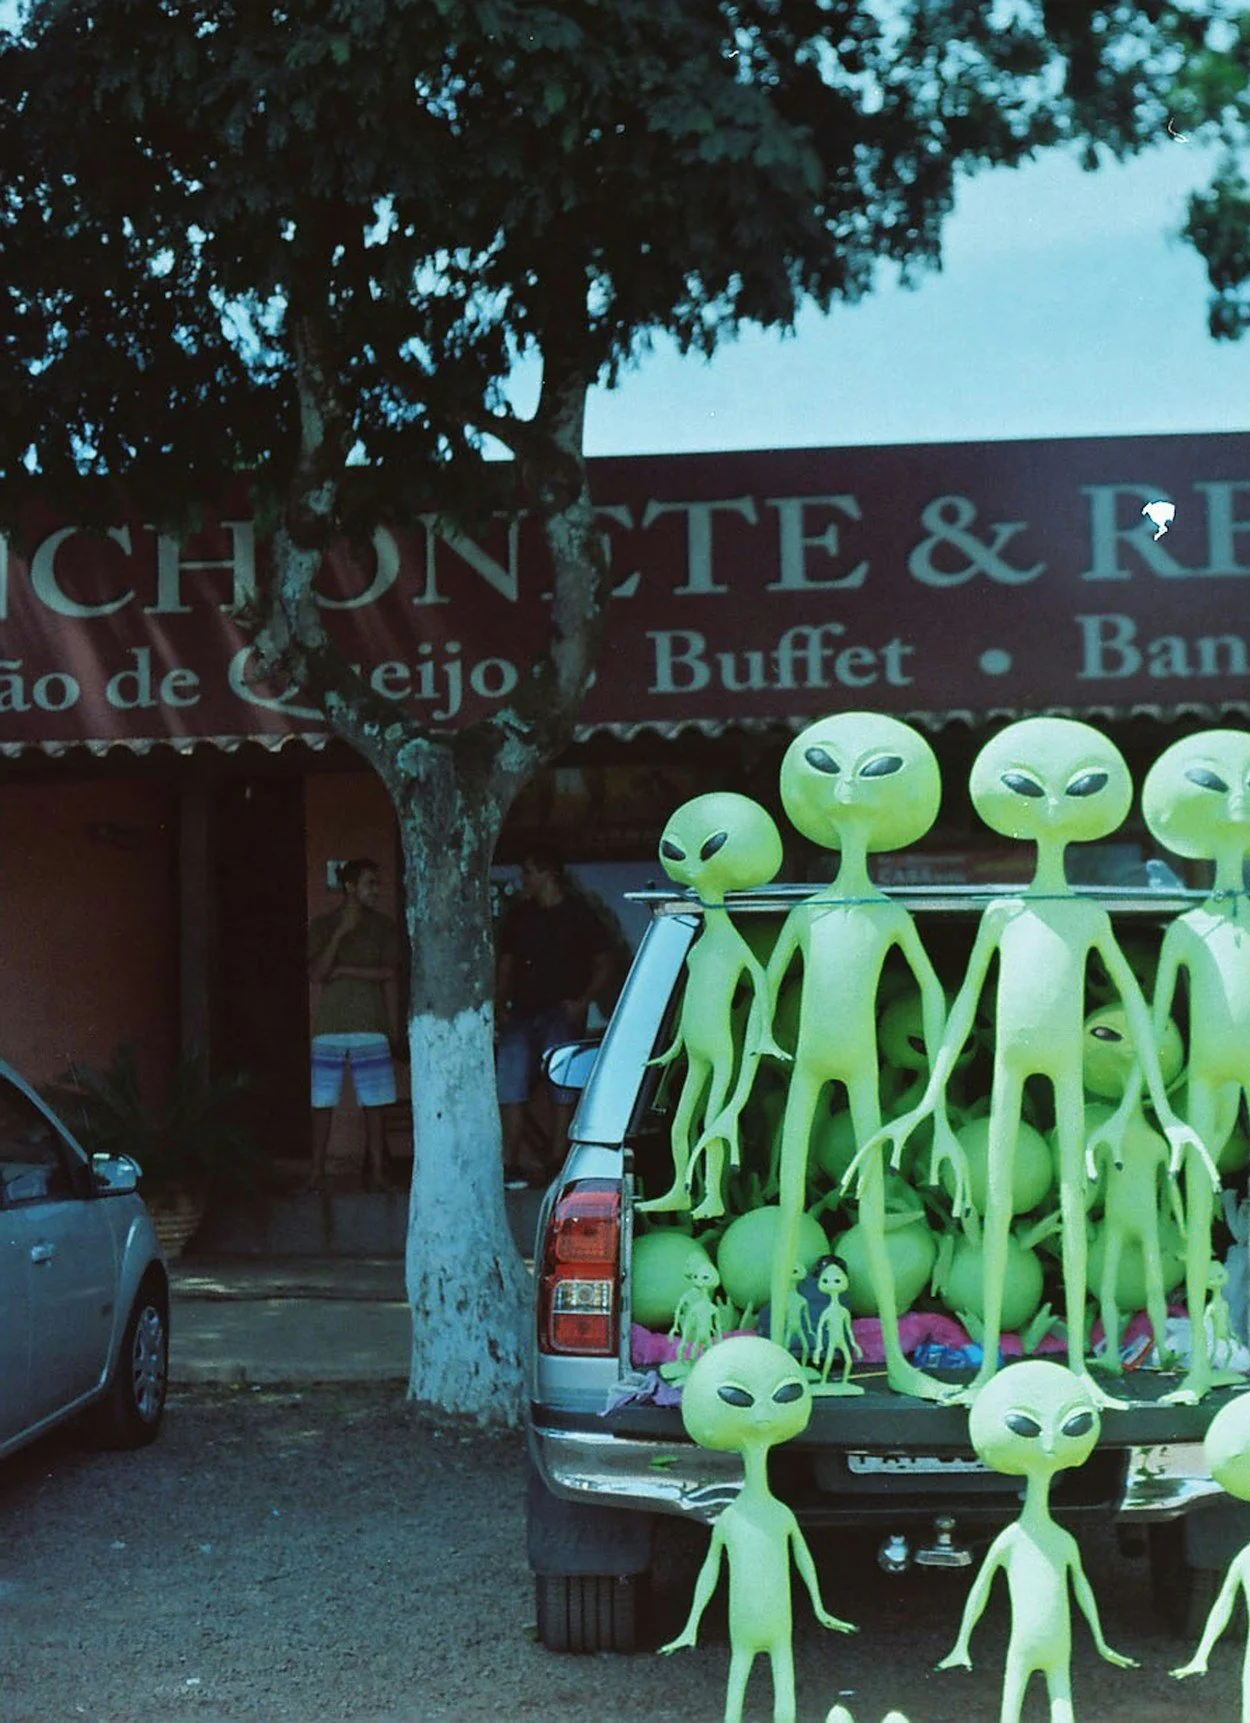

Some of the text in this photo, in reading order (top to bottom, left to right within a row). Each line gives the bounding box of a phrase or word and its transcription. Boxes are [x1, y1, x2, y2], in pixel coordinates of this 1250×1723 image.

[908, 495, 1047, 586] &
[105, 646, 202, 710] de
[646, 622, 916, 694] Buffet
